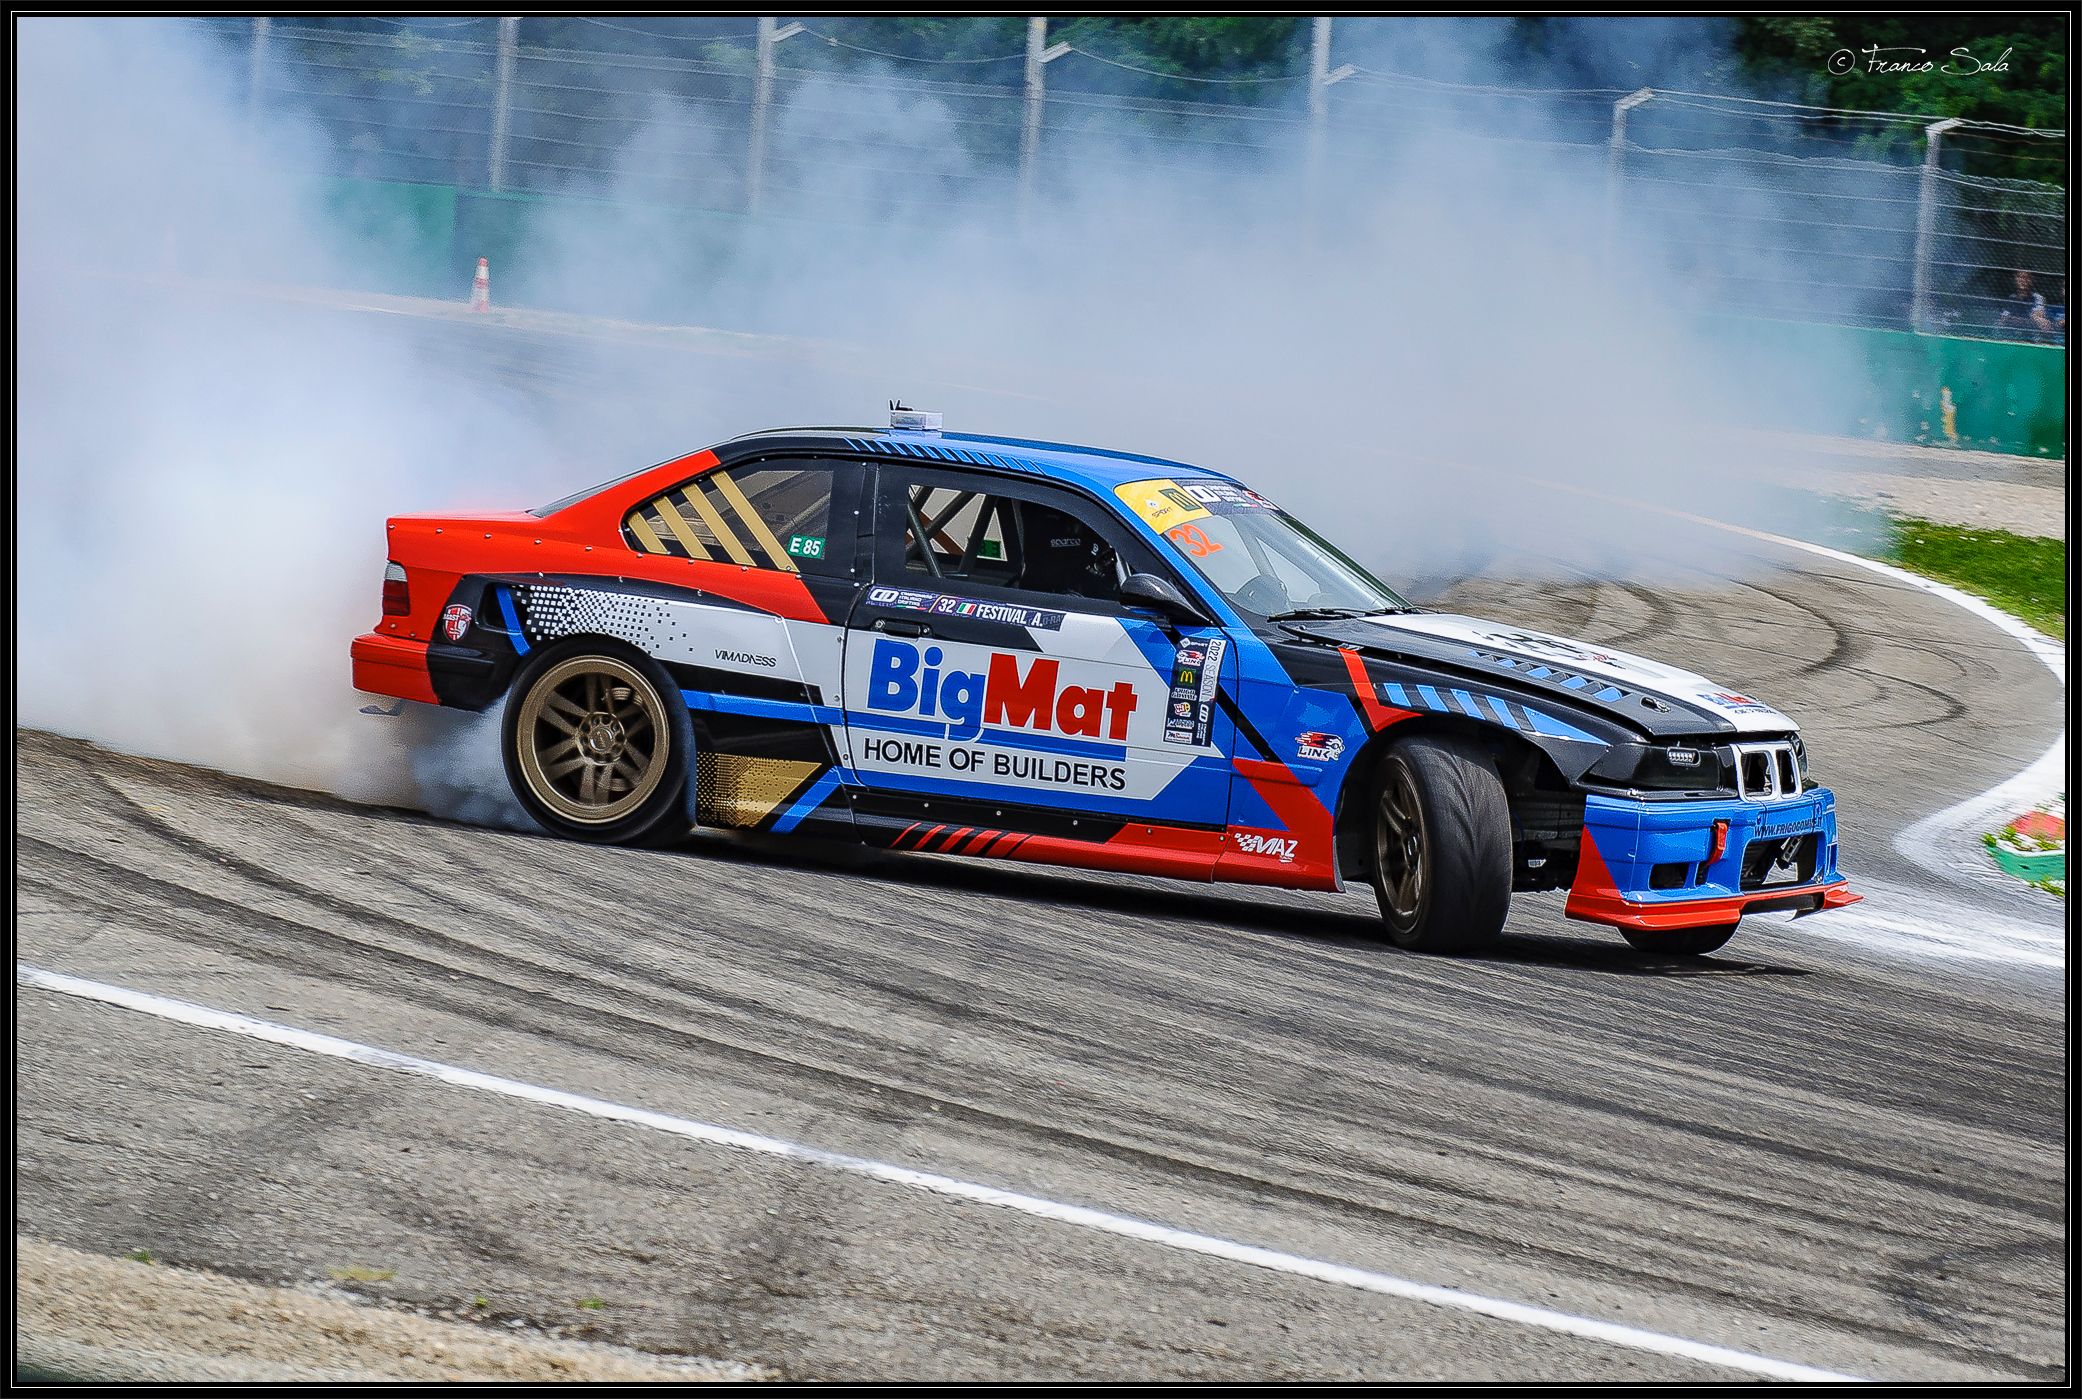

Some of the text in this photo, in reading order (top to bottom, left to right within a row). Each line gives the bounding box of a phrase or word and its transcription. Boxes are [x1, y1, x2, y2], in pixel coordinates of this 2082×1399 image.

[789, 537, 821, 556] E 85
[1168, 523, 1224, 558] 32
[938, 599, 1043, 627] 32 FESTIVAL A.
[714, 648, 777, 668] VIMADNESS
[1201, 640, 1222, 698] 2022 SEASON
[867, 638, 1139, 742] BigMat
[863, 738, 1127, 791] HOME OF BUILDERS
[1299, 746, 1331, 760] LINK
[1252, 836, 1299, 858] MAZ
